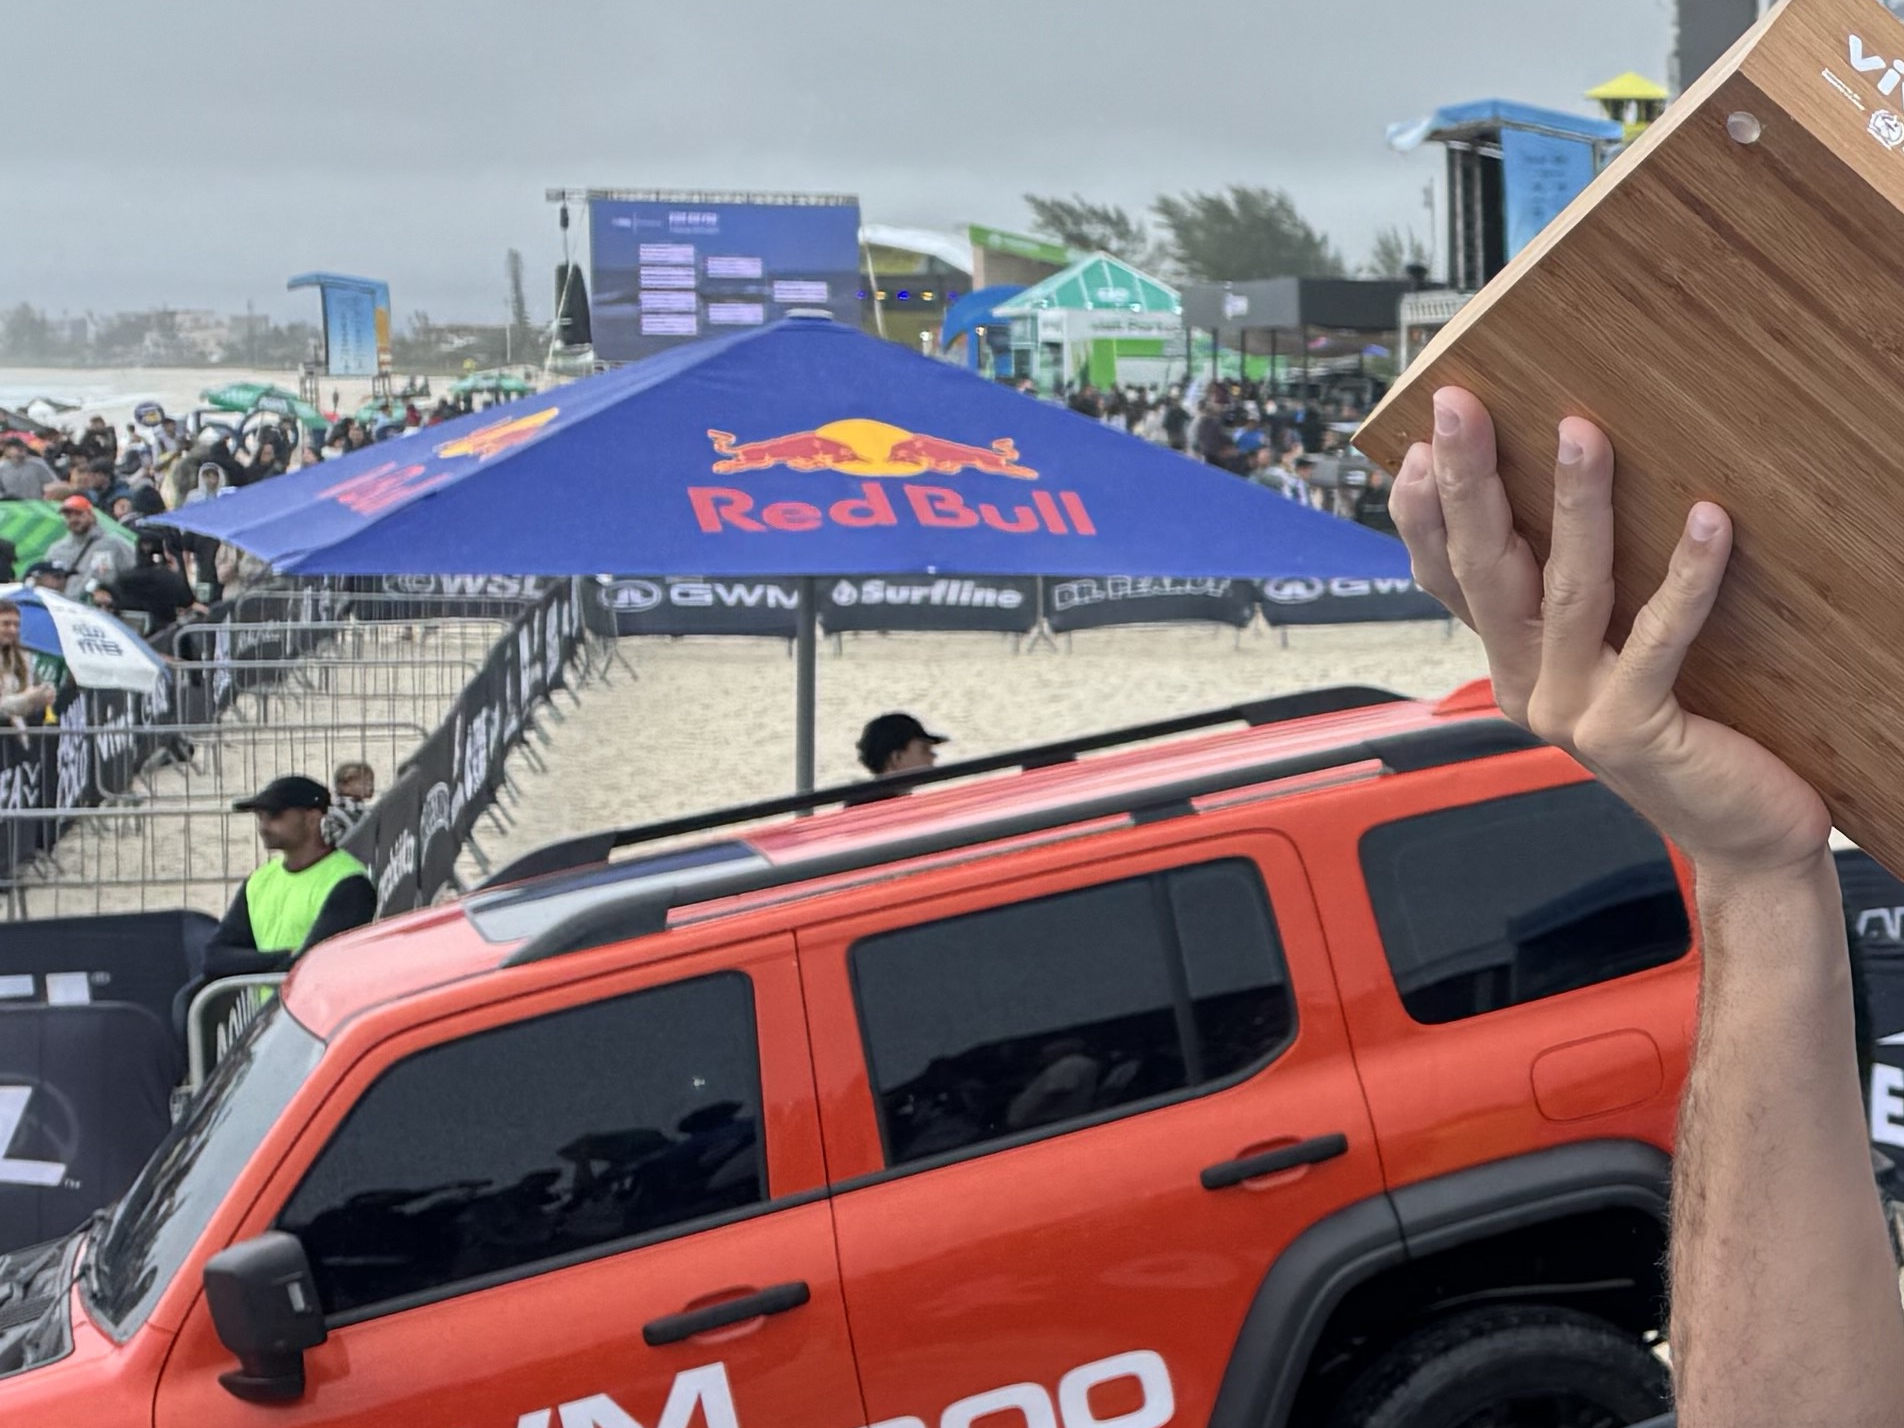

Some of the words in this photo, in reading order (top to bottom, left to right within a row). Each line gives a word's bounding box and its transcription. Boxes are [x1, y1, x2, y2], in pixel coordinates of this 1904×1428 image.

[686, 482, 898, 534] Red
[908, 488, 1098, 536] Bull
[859, 579, 1023, 610] Surfline
[1330, 576, 1420, 597] GW
